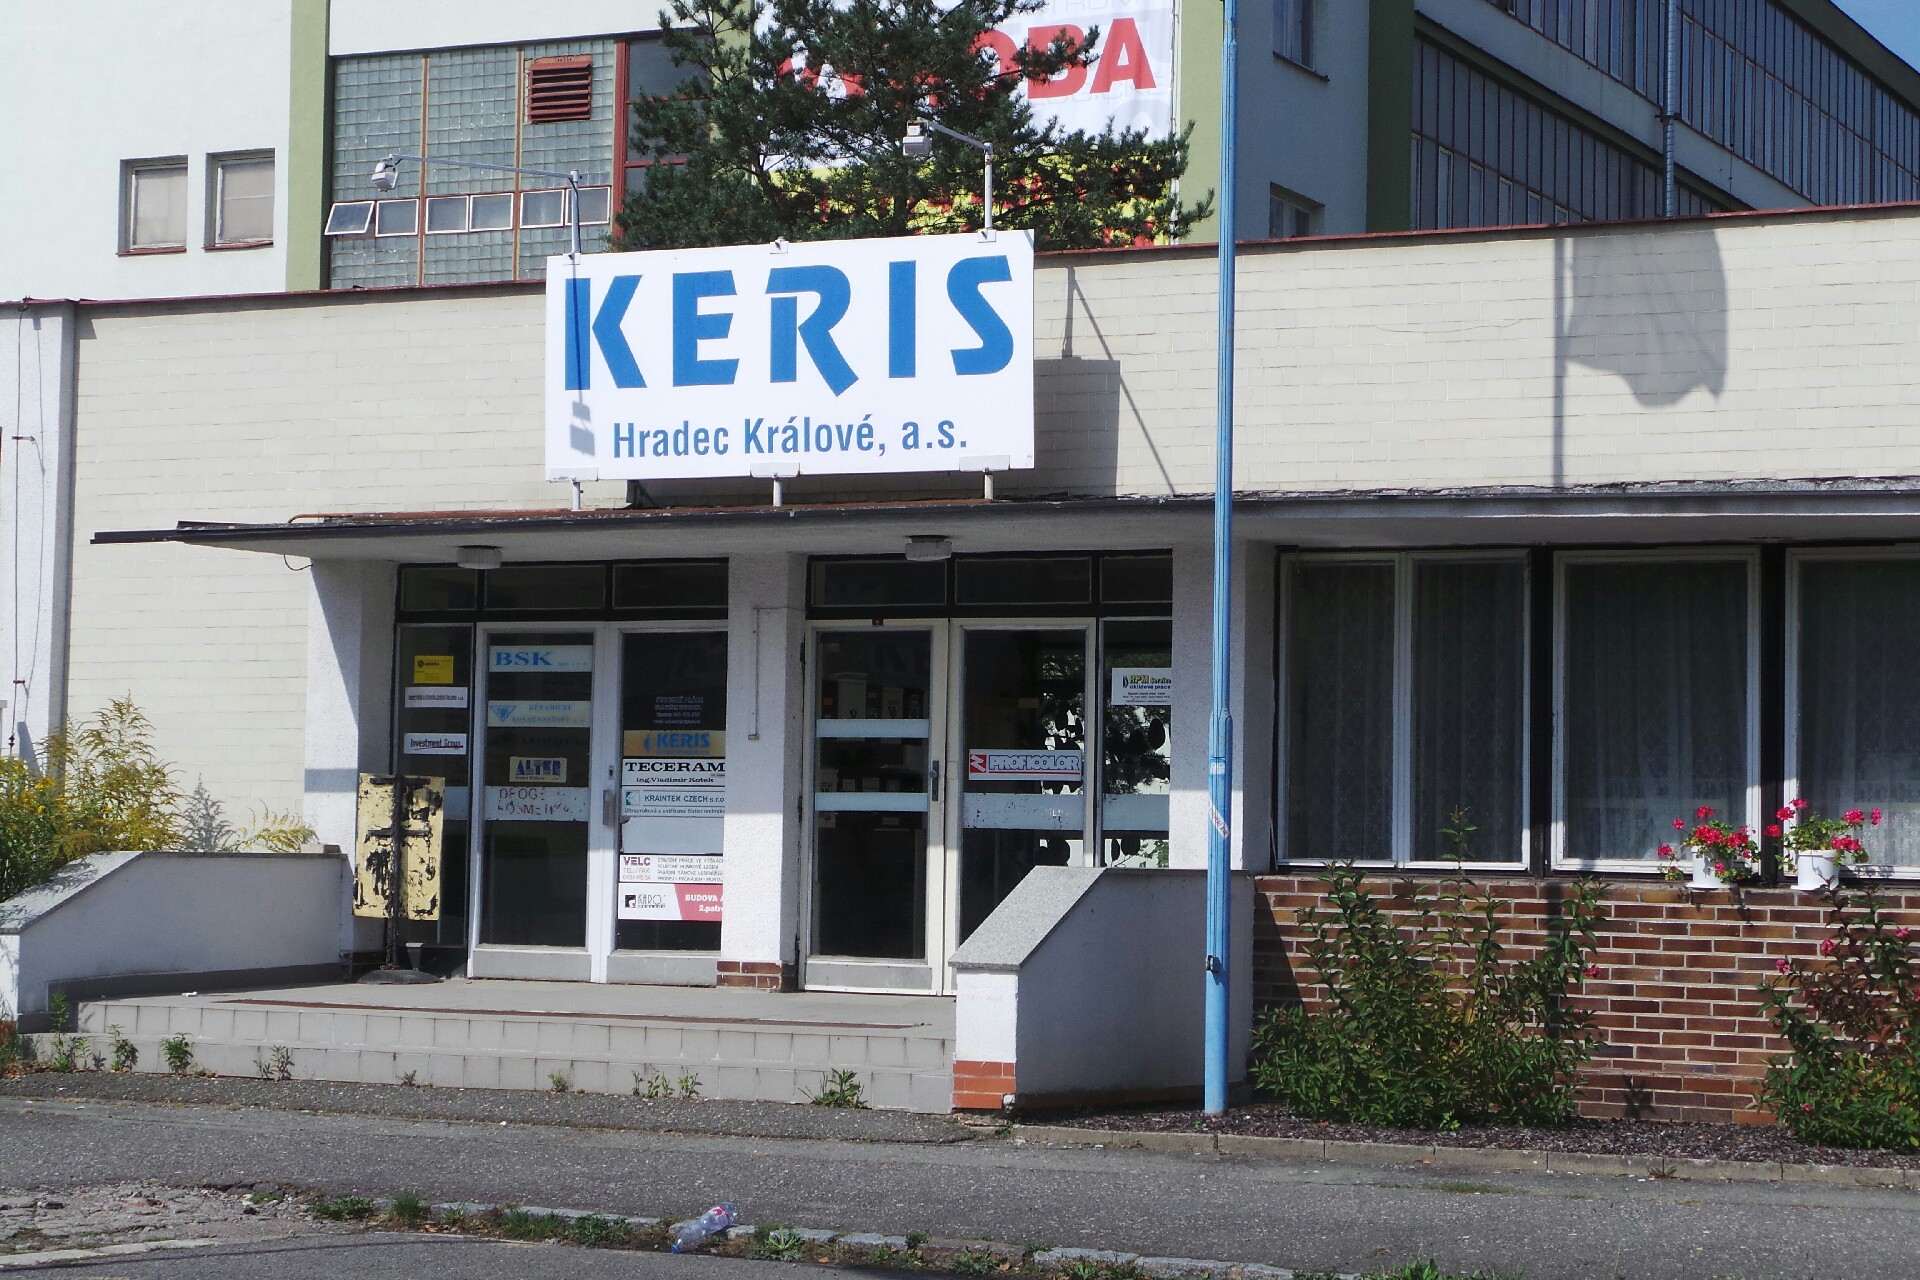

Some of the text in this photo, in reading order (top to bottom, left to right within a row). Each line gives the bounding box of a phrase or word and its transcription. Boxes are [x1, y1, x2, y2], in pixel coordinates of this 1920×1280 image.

[565, 255, 1014, 397] KERIS
[613, 413, 967, 459] Hradec Králové, a.s.
[494, 651, 553, 666] BSK
[410, 737, 442, 748] Investment
[656, 732, 710, 748] KERIS
[625, 761, 725, 772] TECERAM
[988, 754, 1080, 771] PROFICOLOR
[683, 795, 708, 803] CZECH
[685, 894, 718, 902] BUDOVA
